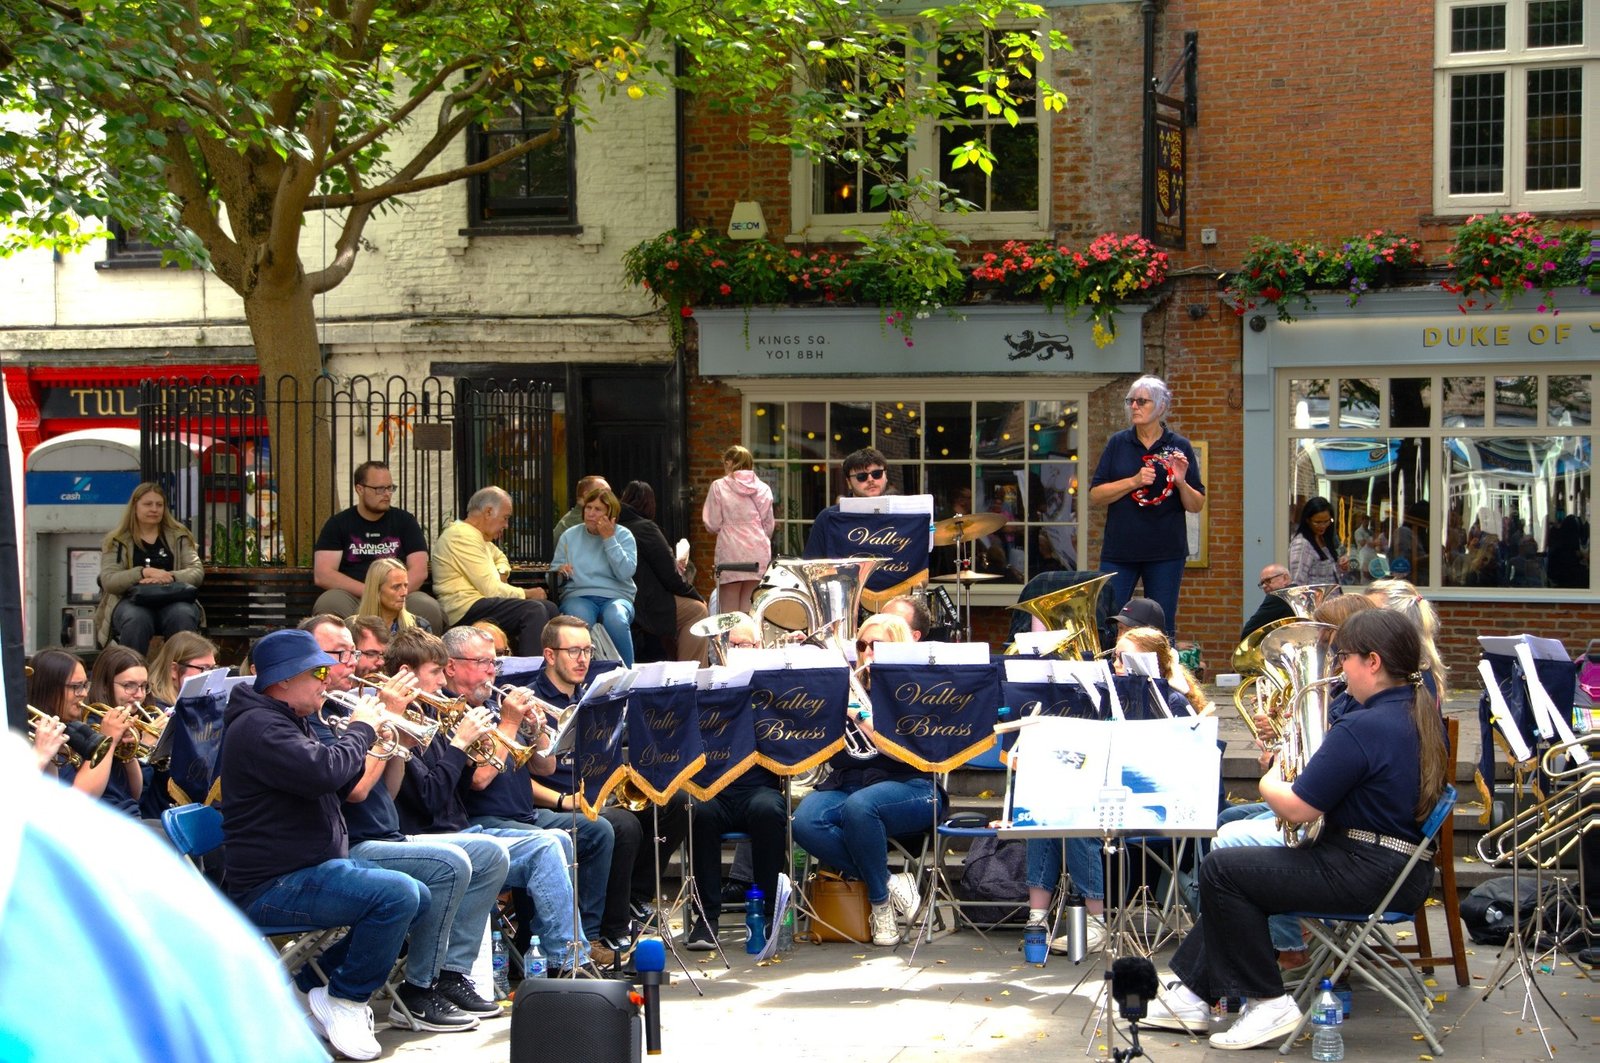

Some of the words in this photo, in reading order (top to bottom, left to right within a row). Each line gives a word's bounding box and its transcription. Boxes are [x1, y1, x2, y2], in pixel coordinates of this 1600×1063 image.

[731, 221, 760, 230] SECOM
[758, 335, 801, 345] KINGS
[807, 335, 831, 345] SQ.
[1423, 325, 1512, 348] DUKE
[1528, 323, 1573, 345] OF
[797, 350, 824, 359] 8BH
[352, 547, 396, 555] ENERGY
[358, 541, 400, 550] UNIQUE
[847, 526, 912, 553] Valley
[751, 686, 827, 718] Valley
[895, 681, 976, 713] Valley
[753, 718, 826, 741] Brass
[895, 714, 973, 738] Brass
